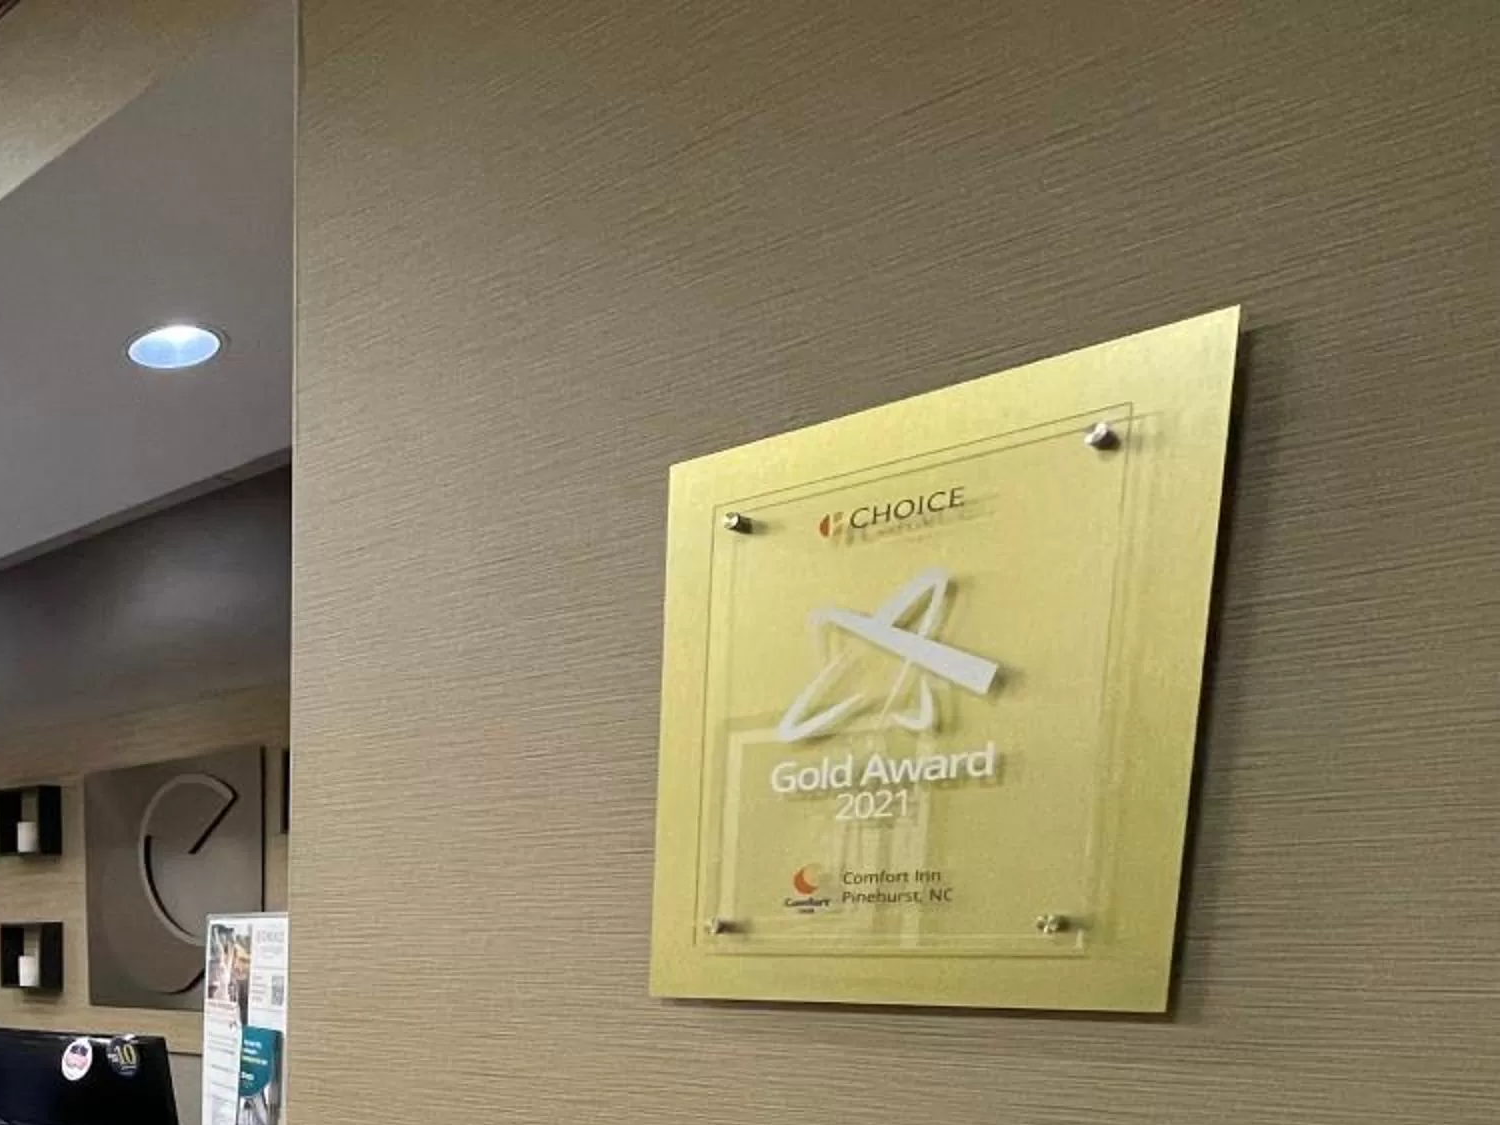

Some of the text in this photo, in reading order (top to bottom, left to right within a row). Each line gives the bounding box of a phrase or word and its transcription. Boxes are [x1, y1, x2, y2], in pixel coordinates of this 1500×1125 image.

[850, 486, 965, 529] CHOICE
[771, 741, 995, 793] Gold Award
[835, 788, 908, 821] 2021
[843, 869, 941, 885] Comfort Inn
[929, 887, 954, 903] NC
